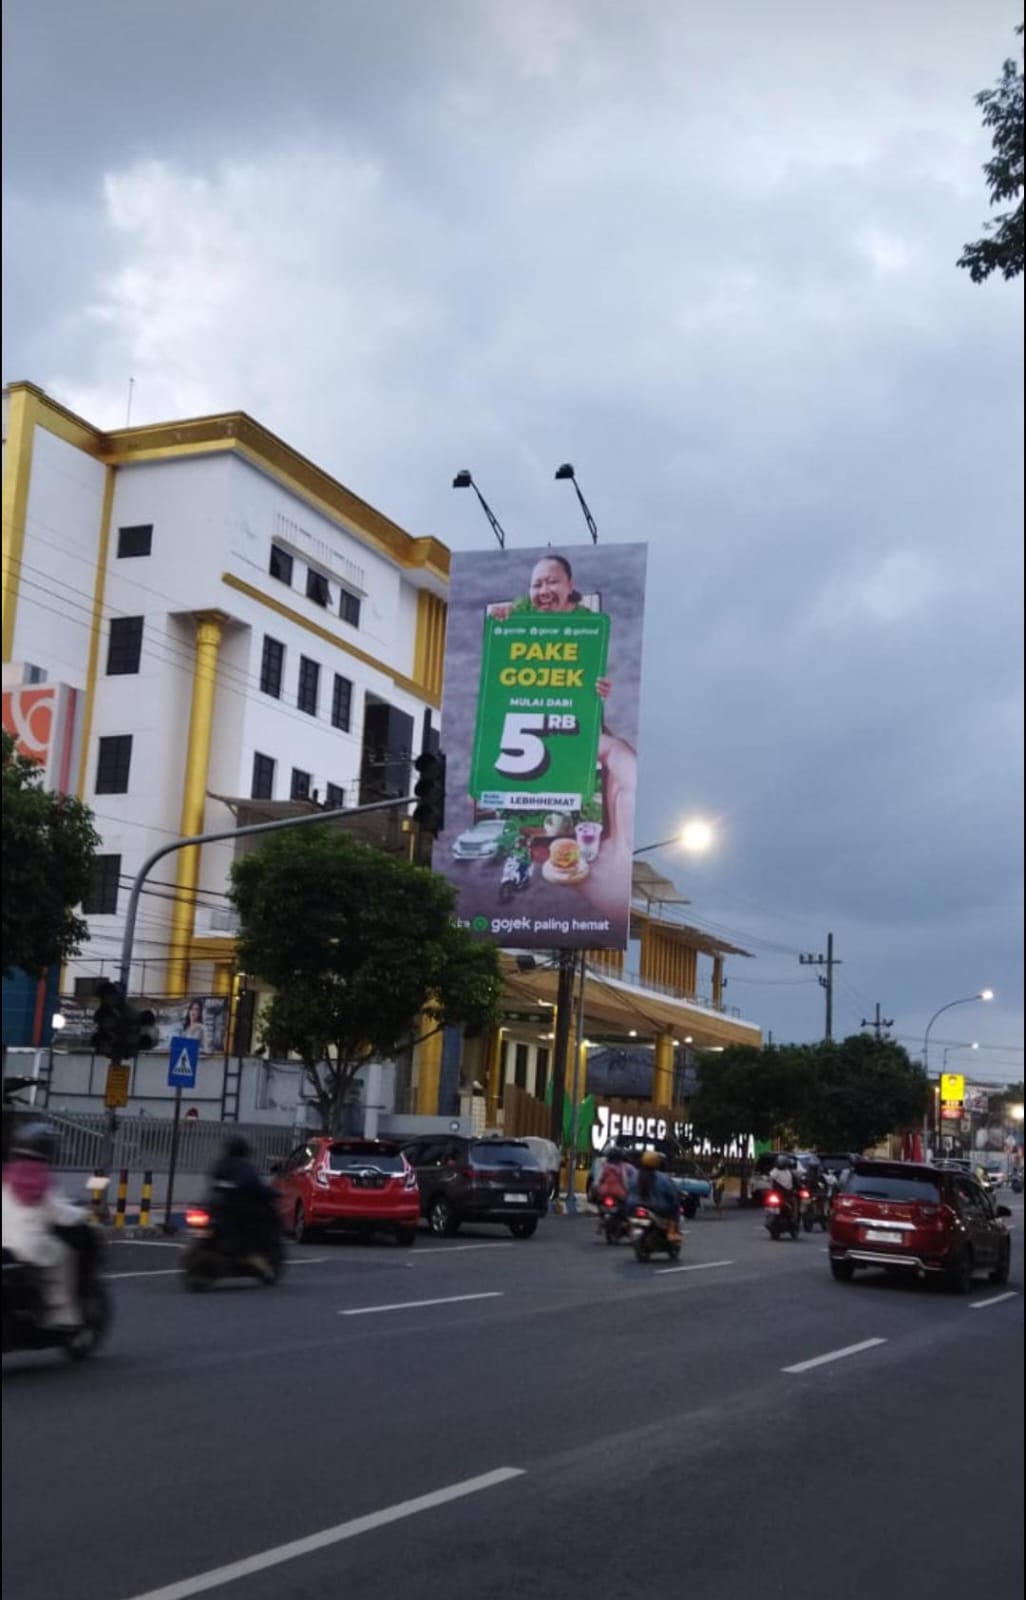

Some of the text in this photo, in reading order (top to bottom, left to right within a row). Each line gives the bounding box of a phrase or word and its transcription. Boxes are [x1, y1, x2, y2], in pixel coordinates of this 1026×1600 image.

[509, 642, 578, 661] PAKE
[499, 667, 584, 687] GOJEK
[509, 697, 573, 707] MULAI DARI
[494, 712, 577, 774] 5 RB
[491, 916, 609, 934] gojek paling hemat
